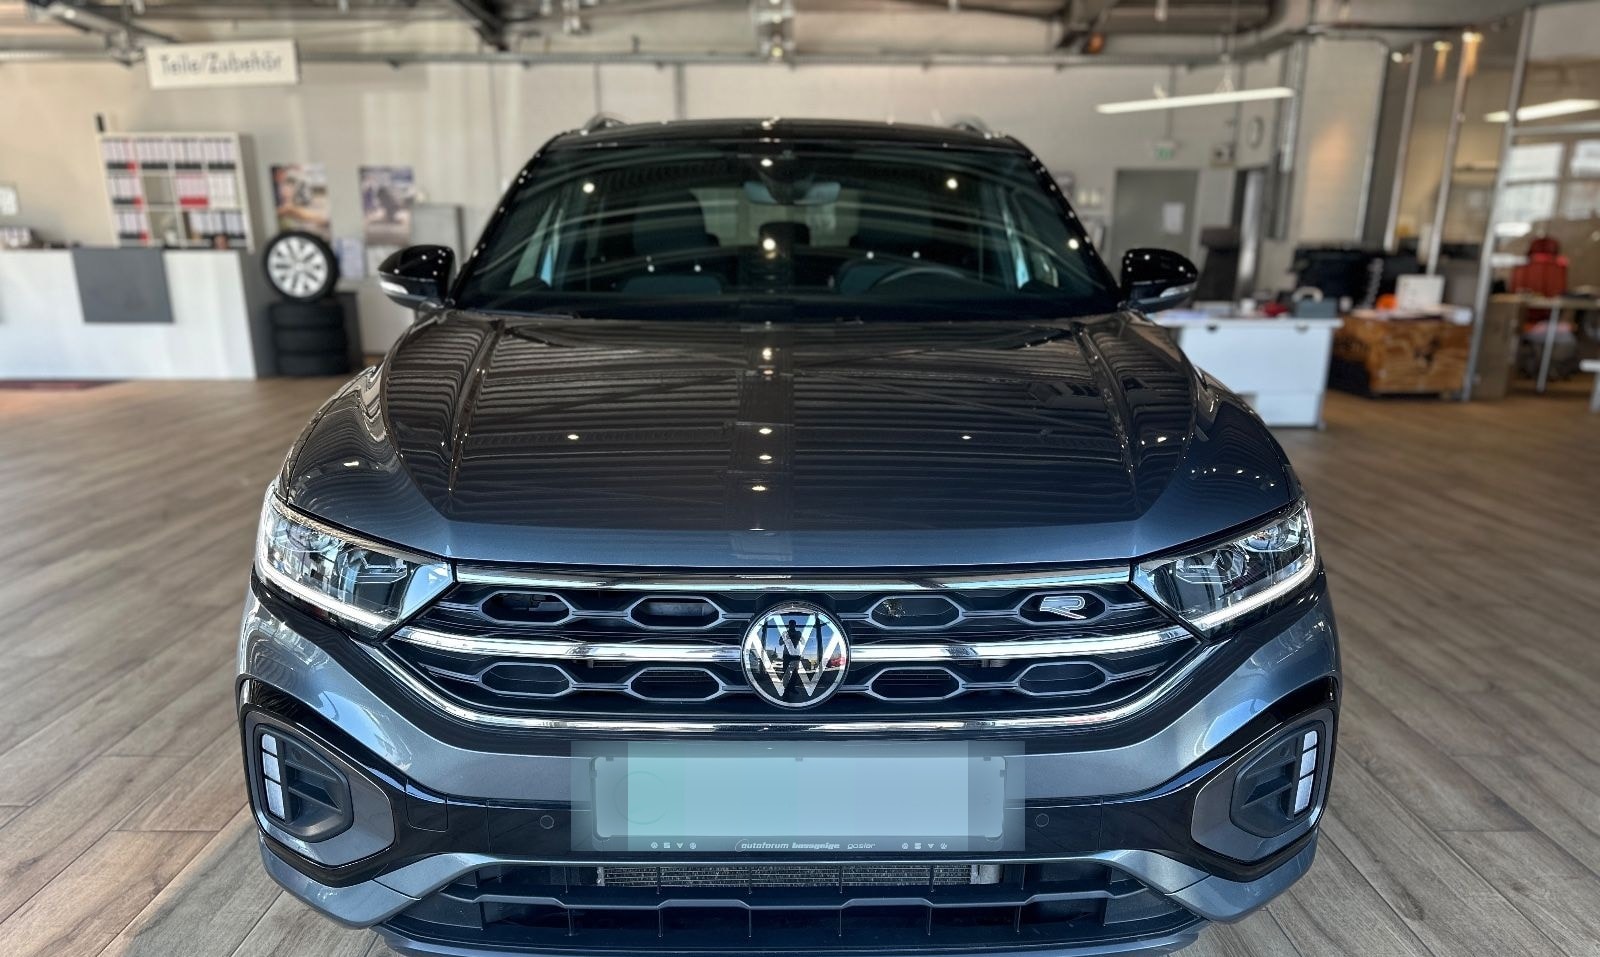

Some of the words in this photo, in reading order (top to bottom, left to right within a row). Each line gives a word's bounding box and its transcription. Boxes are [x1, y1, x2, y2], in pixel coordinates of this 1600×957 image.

[160, 50, 282, 75] Teile/Zubehör
[1039, 595, 1087, 620] R
[740, 841, 790, 849] autoforum
